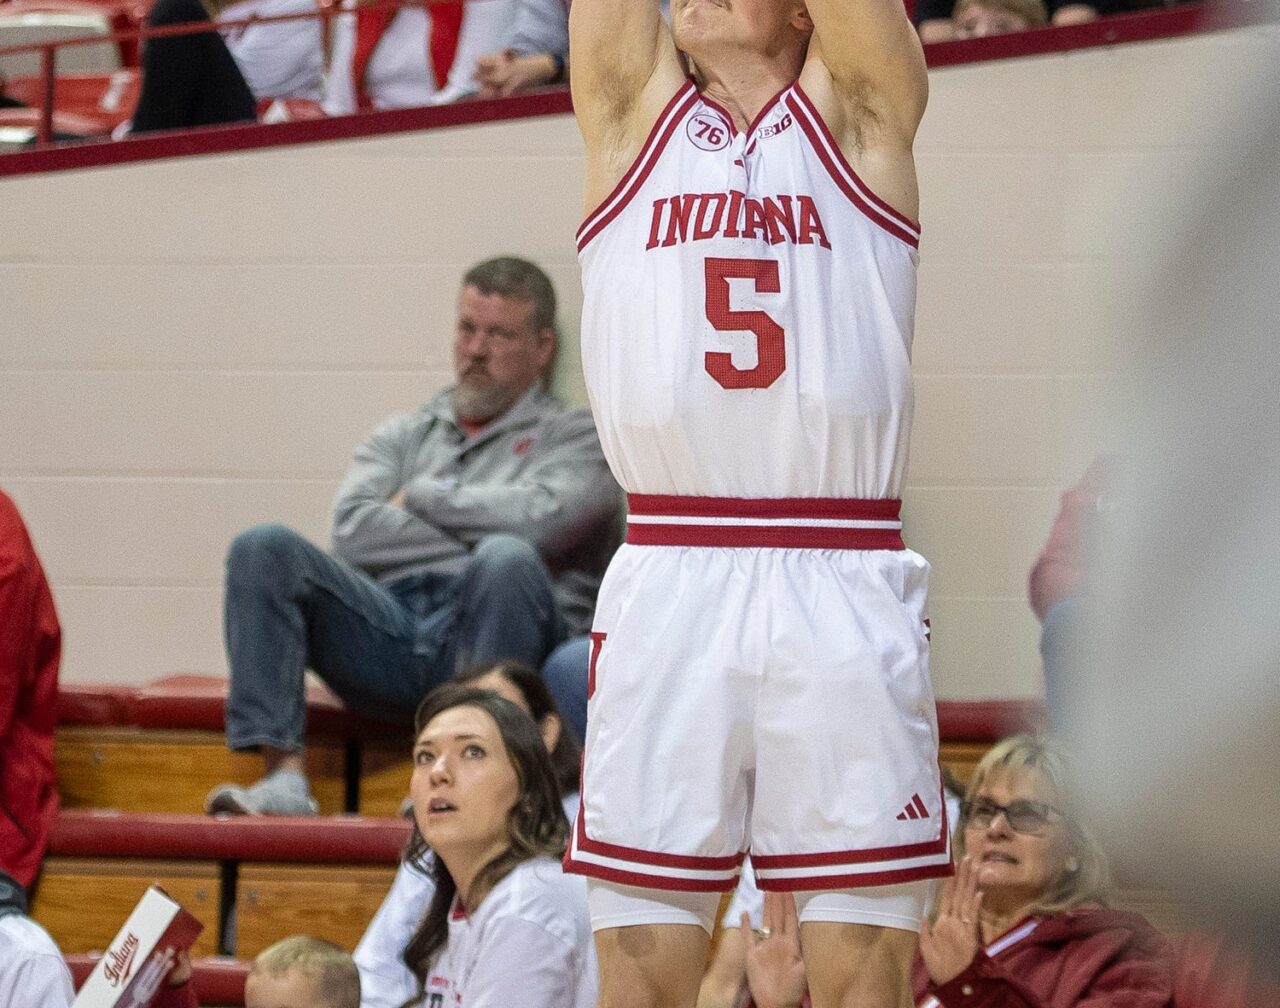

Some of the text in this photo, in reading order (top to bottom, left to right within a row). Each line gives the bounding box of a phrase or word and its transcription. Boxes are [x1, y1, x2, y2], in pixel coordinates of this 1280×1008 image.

[646, 191, 832, 251] INDIANA
[704, 257, 786, 389] 5
[104, 931, 139, 988] Indiana
